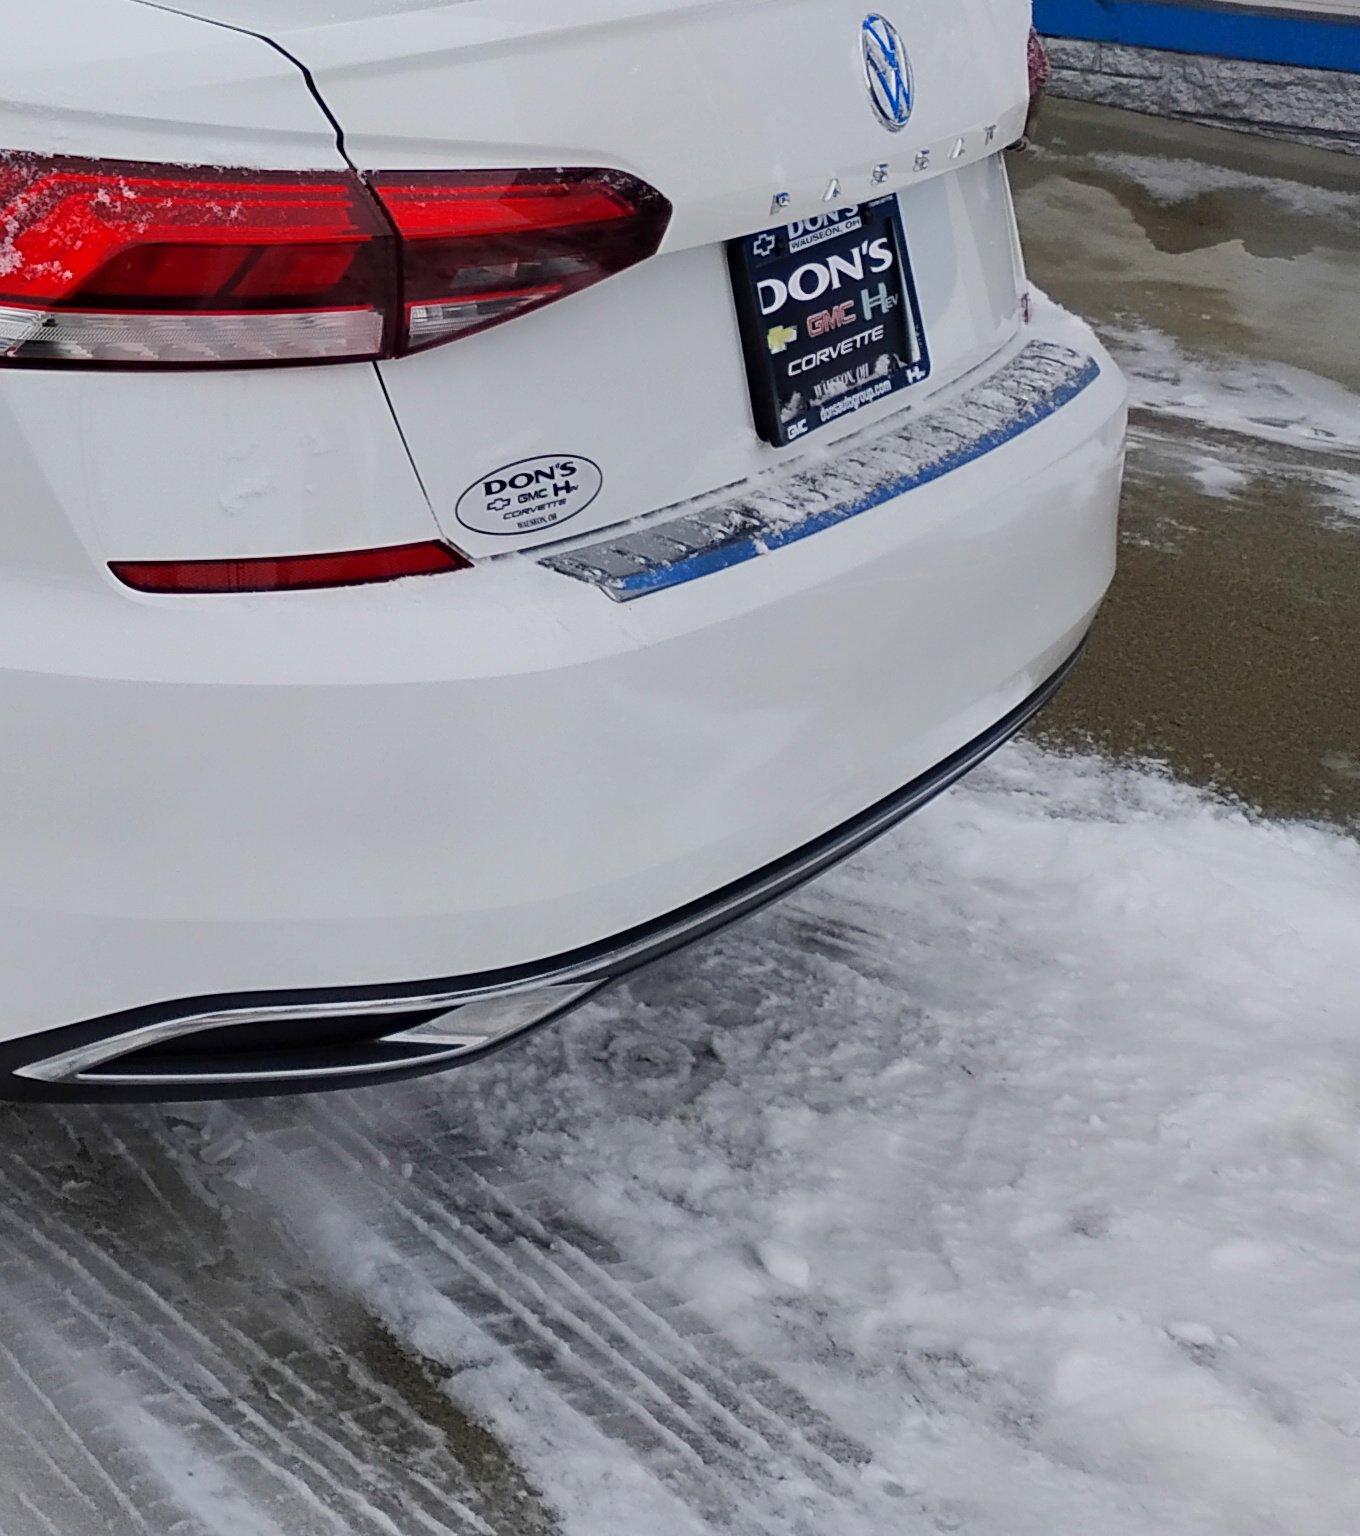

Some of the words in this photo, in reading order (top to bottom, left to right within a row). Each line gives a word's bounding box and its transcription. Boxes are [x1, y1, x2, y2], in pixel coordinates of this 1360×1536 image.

[770, 124, 998, 216] PASSAT
[787, 205, 859, 240] DONS
[791, 226, 843, 250] WAUSEON,
[757, 237, 893, 315] DON'S
[806, 300, 857, 338] GMC
[788, 325, 885, 387] CORVETTE
[820, 380, 893, 423] donsautogroup.com
[483, 461, 578, 497] DON'S
[517, 488, 548, 504] GMC
[503, 498, 567, 520] CORVETTE
